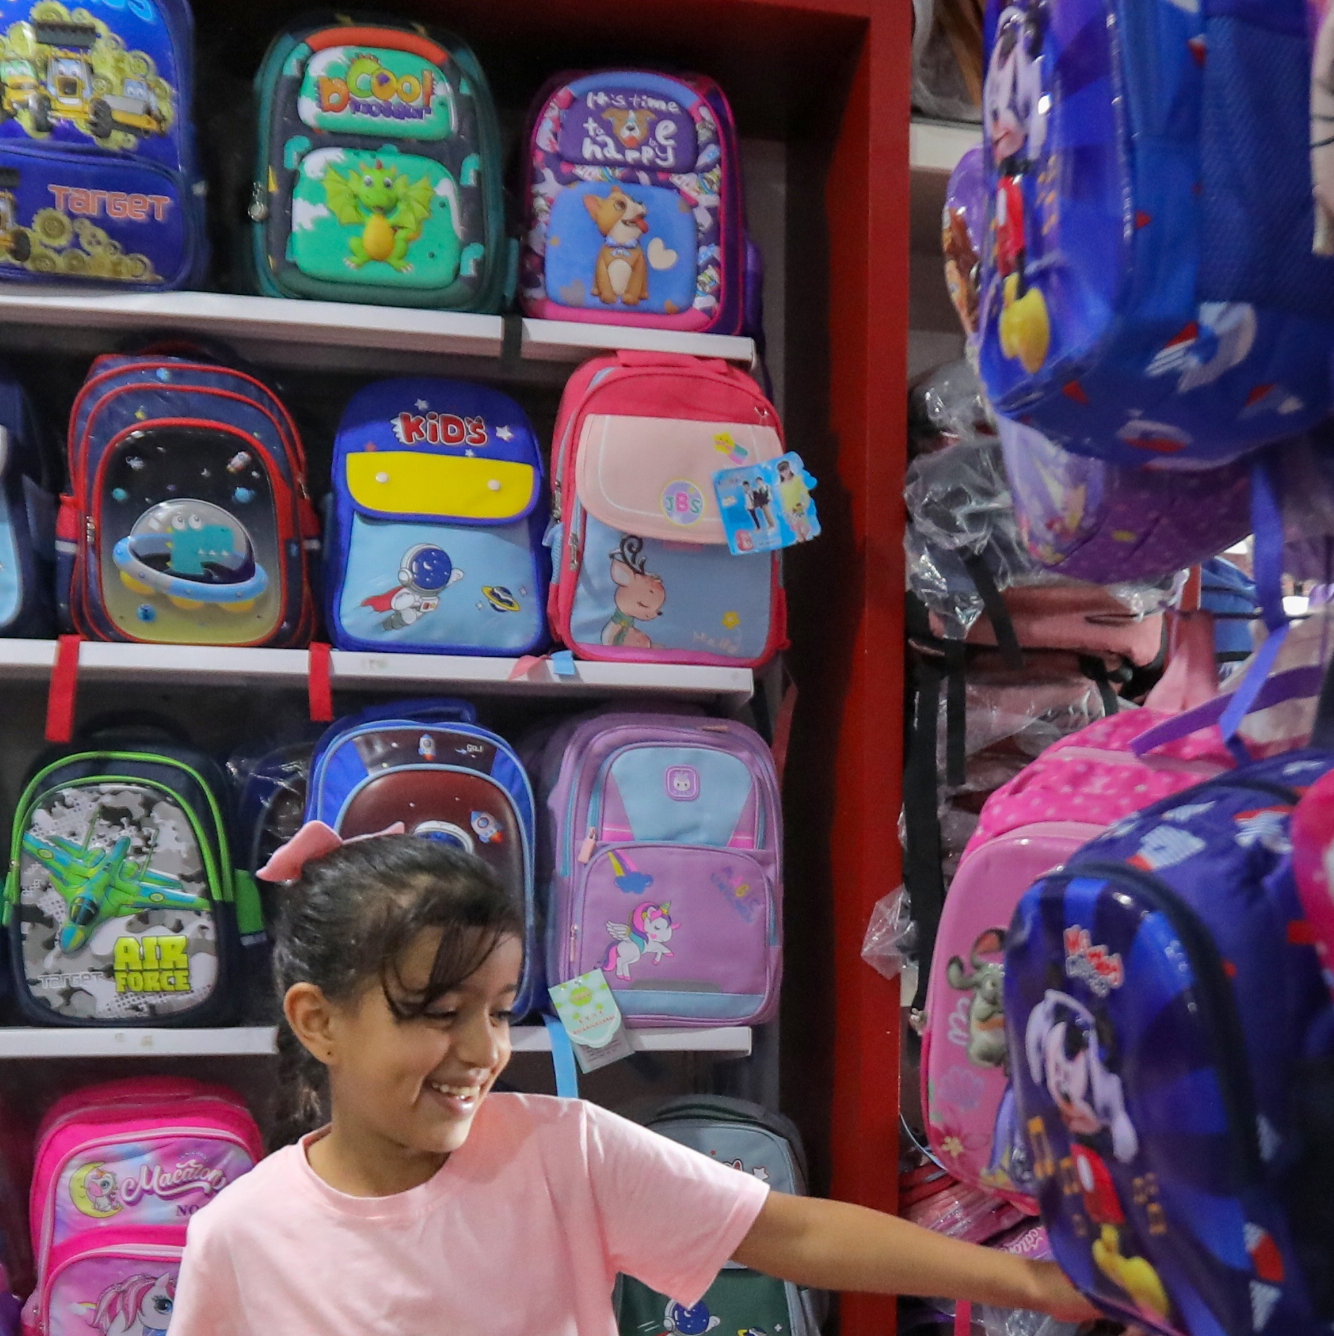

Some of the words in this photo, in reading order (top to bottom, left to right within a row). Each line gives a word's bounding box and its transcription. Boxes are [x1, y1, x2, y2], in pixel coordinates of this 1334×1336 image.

[586, 91, 627, 111] It's
[629, 93, 682, 116] time
[582, 117, 606, 139] to
[581, 136, 677, 168] happy
[665, 491, 702, 515] JBS
[113, 934, 190, 971] AIR
[115, 969, 192, 993] FORCE
[120, 1159, 227, 1206] Macaron
